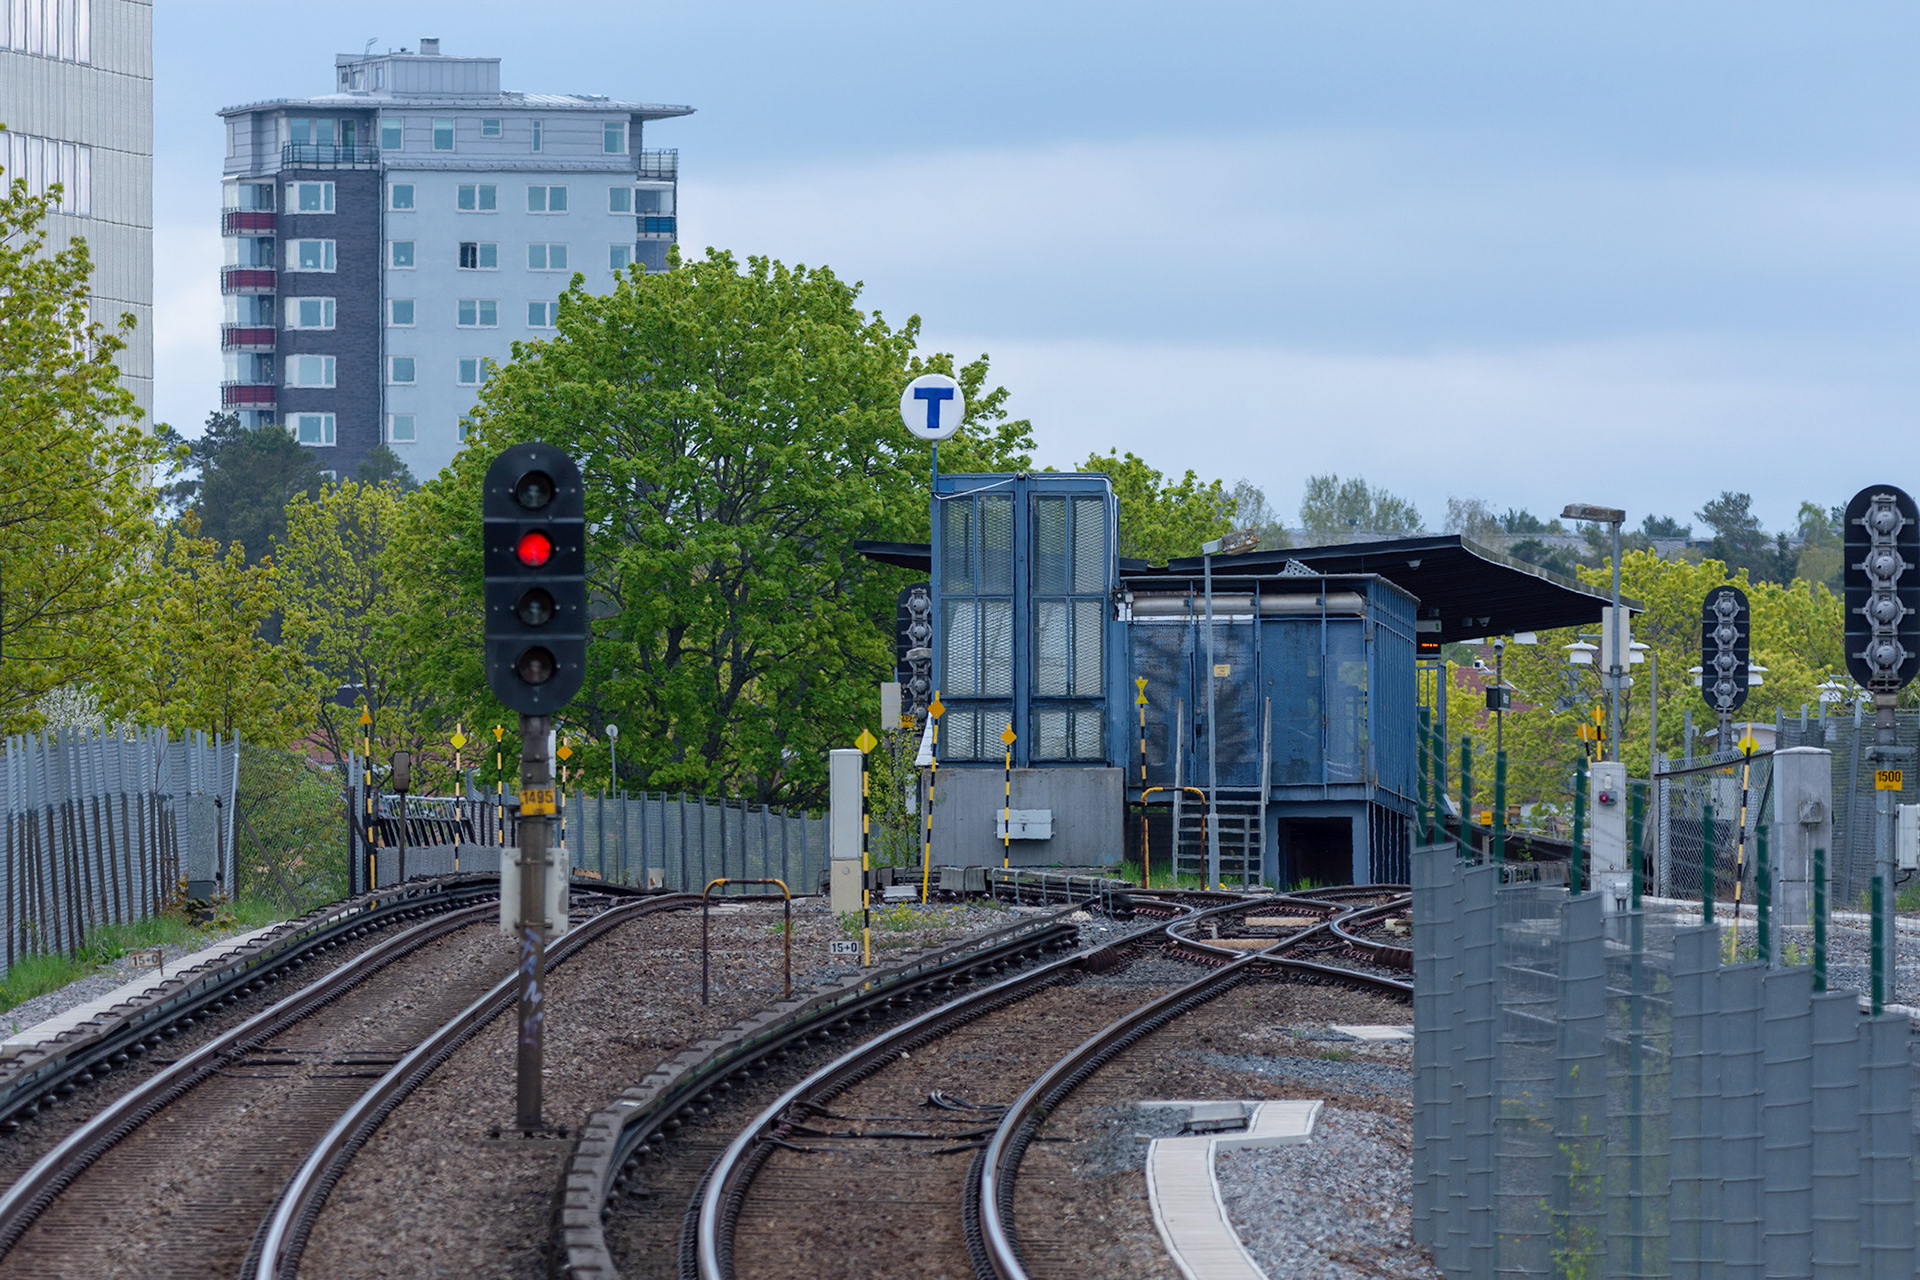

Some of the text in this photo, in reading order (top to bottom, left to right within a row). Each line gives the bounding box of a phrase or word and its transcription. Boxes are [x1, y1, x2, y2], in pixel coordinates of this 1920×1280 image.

[914, 387, 954, 429] T
[1877, 771, 1901, 783] 1500
[523, 791, 554, 804] 1495
[832, 942, 858, 953] 15+0
[132, 954, 159, 967] 15+0
